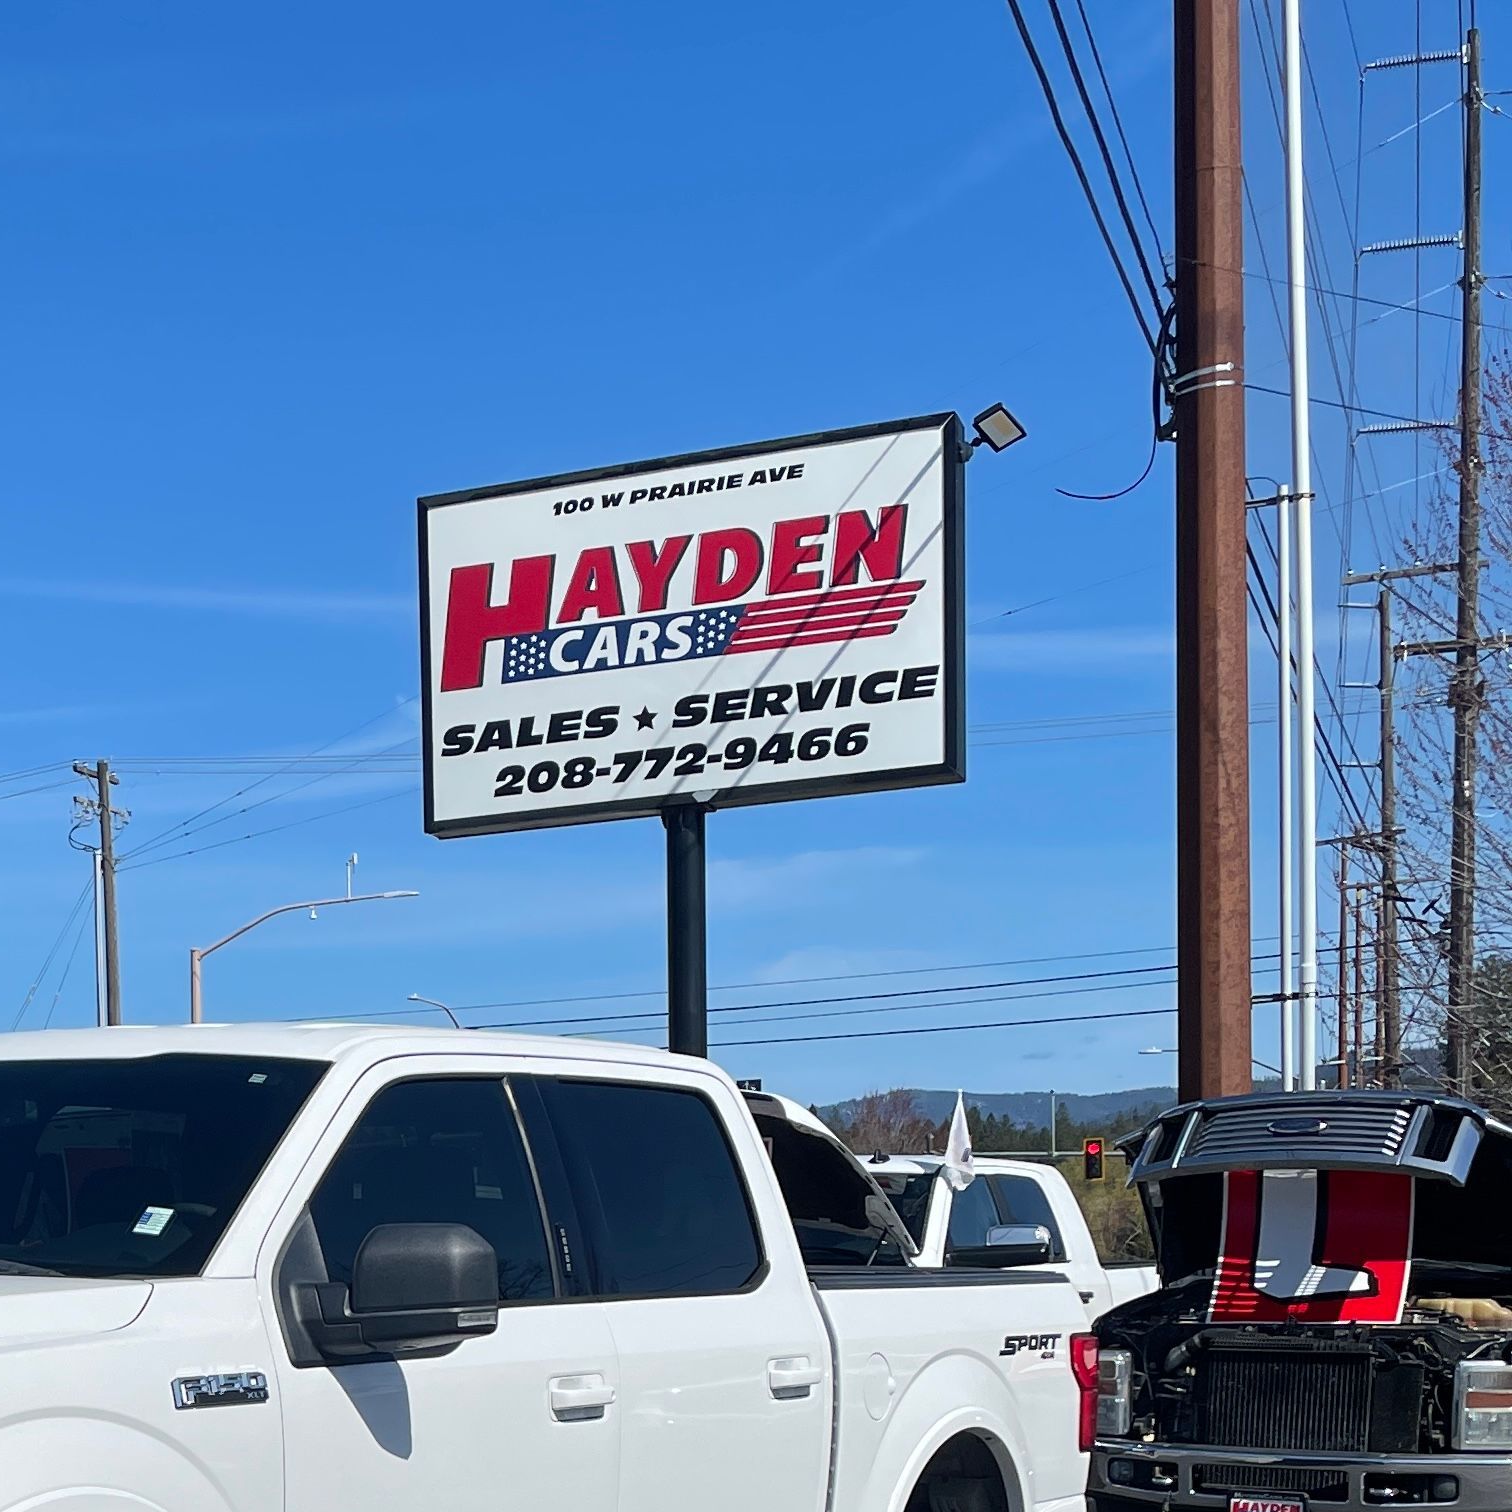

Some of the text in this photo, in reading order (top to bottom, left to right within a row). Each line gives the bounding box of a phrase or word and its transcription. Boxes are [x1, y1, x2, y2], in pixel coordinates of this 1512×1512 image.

[553, 463, 805, 516] 100 W PRAIRIE AVE
[441, 503, 909, 692] HAYDEN
[549, 615, 694, 672] CARS
[441, 664, 941, 757] SALES SERVICE
[493, 723, 870, 798] 208-772-9466
[999, 1334, 1062, 1356] SPORT
[248, 1391, 265, 1399] XLT
